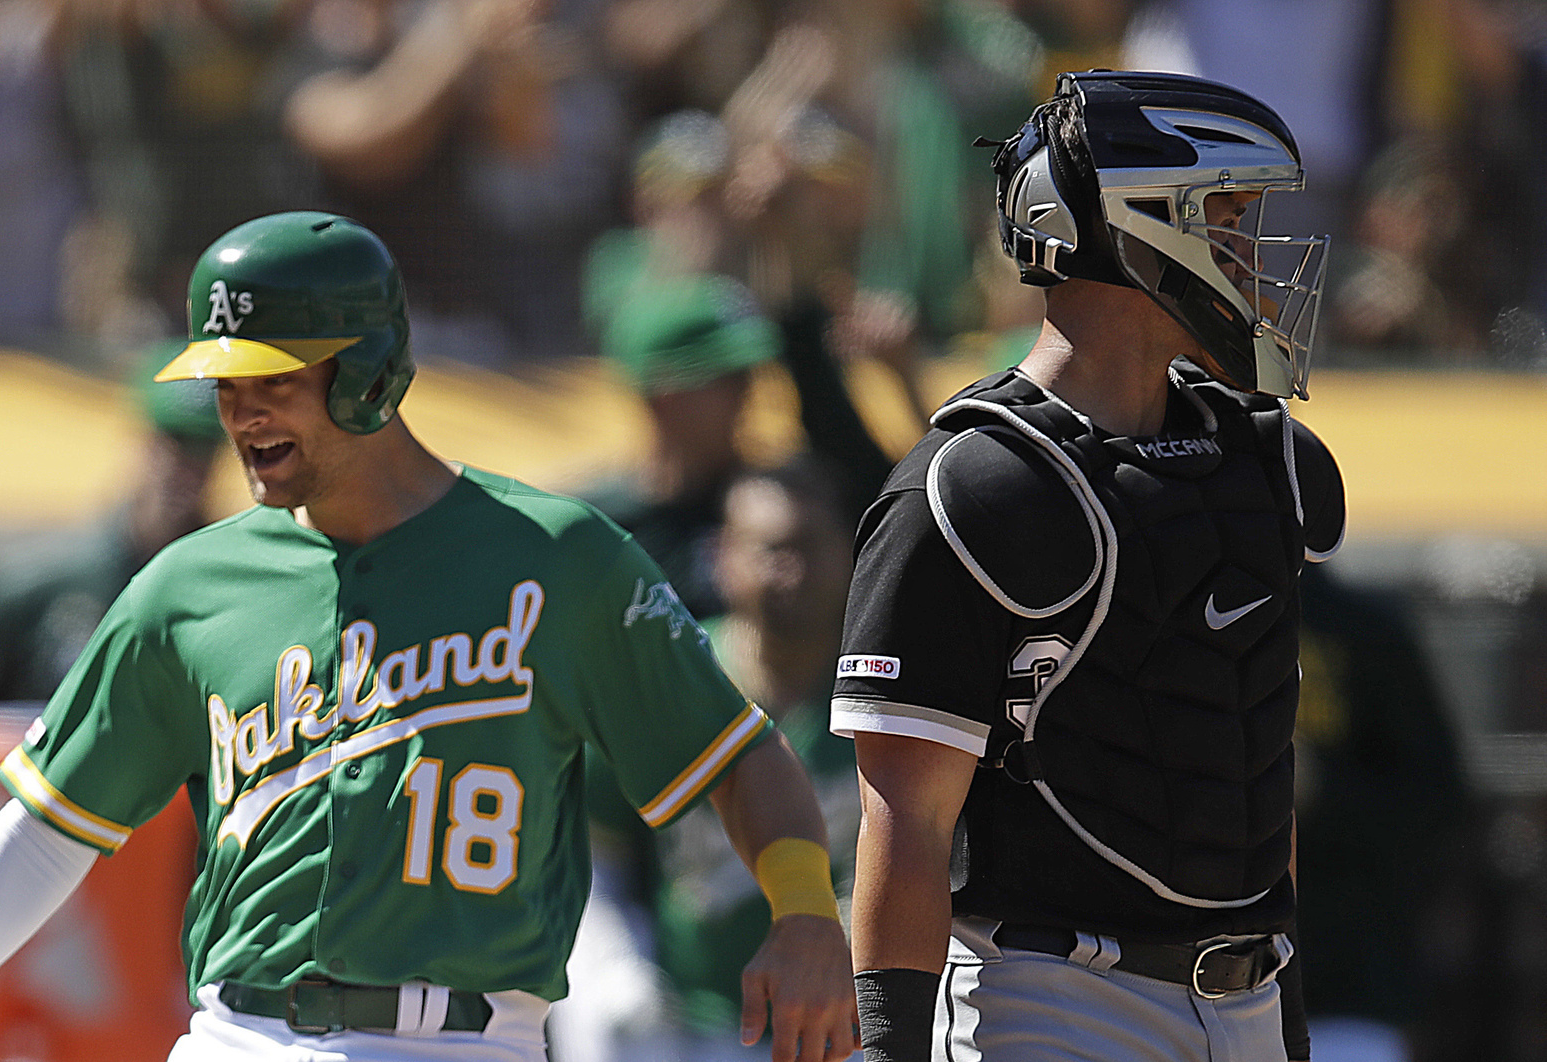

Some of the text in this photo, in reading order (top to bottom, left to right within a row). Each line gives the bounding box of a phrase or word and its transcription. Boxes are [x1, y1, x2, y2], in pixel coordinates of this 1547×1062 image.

[202, 280, 255, 334] A's
[207, 580, 546, 805] Oakland
[869, 659, 895, 674] 150
[402, 756, 525, 895] 18
